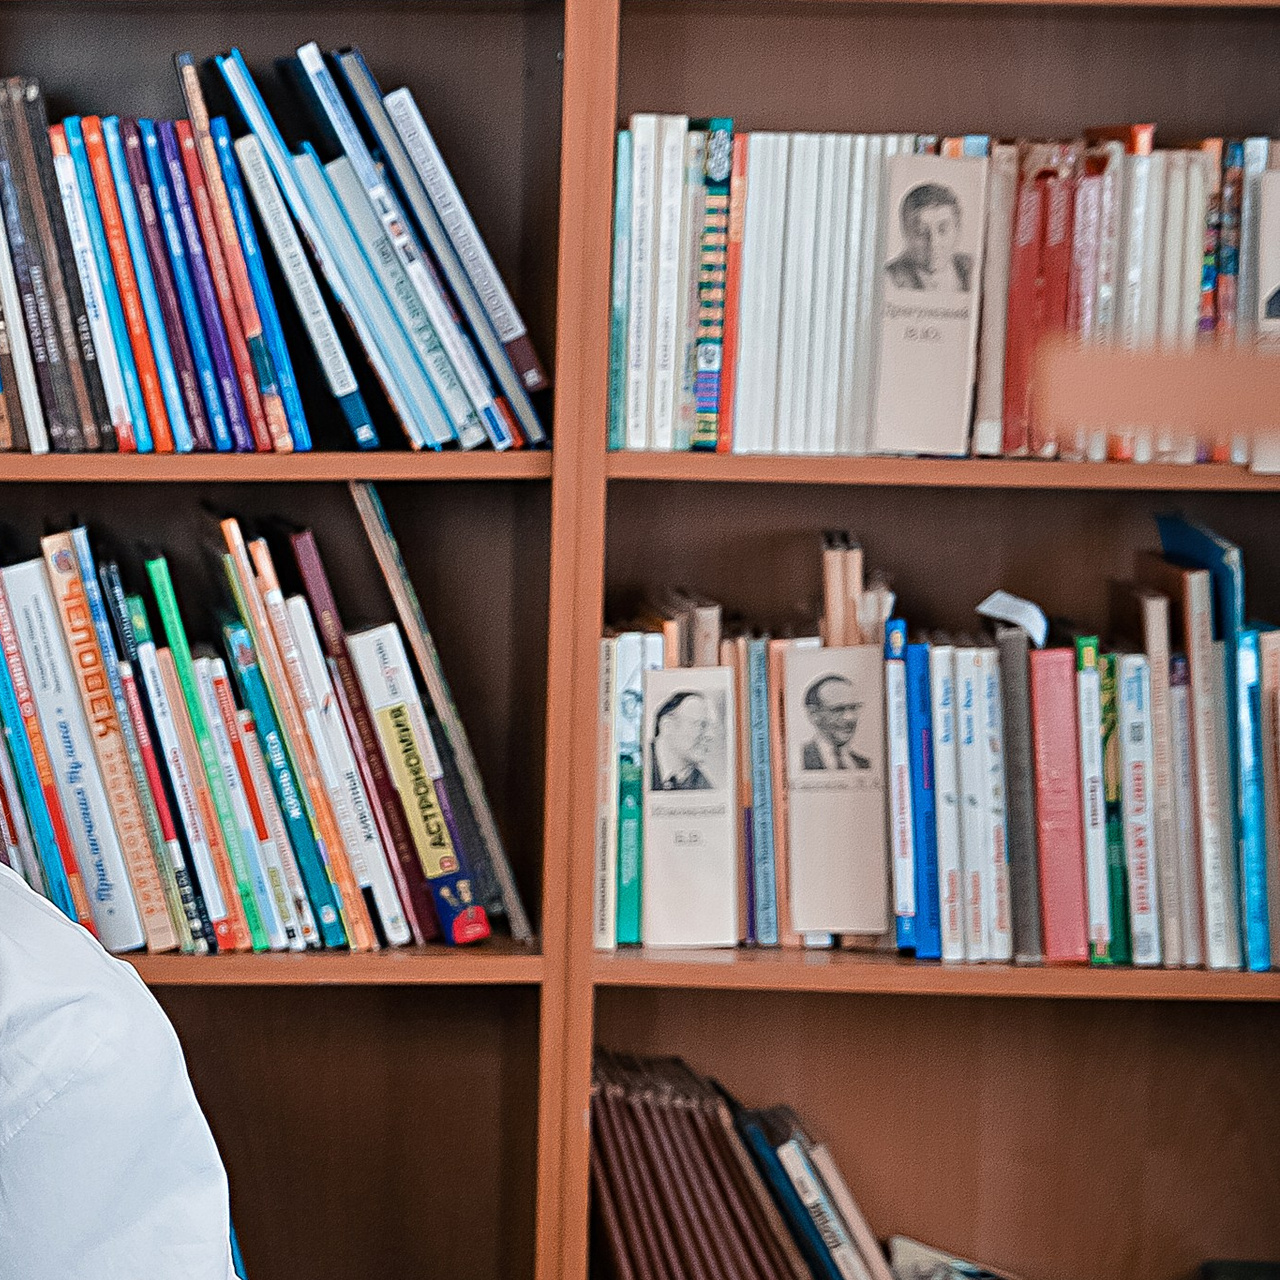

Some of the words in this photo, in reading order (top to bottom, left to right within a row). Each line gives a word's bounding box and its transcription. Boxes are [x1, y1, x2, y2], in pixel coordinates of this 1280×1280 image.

[56, 576, 122, 740] ЧЕЛОВЕК
[264, 729, 288, 770] ЛЕСА
[385, 701, 449, 853] АСТРОНОМИЯ
[66, 783, 118, 905] Приключения
